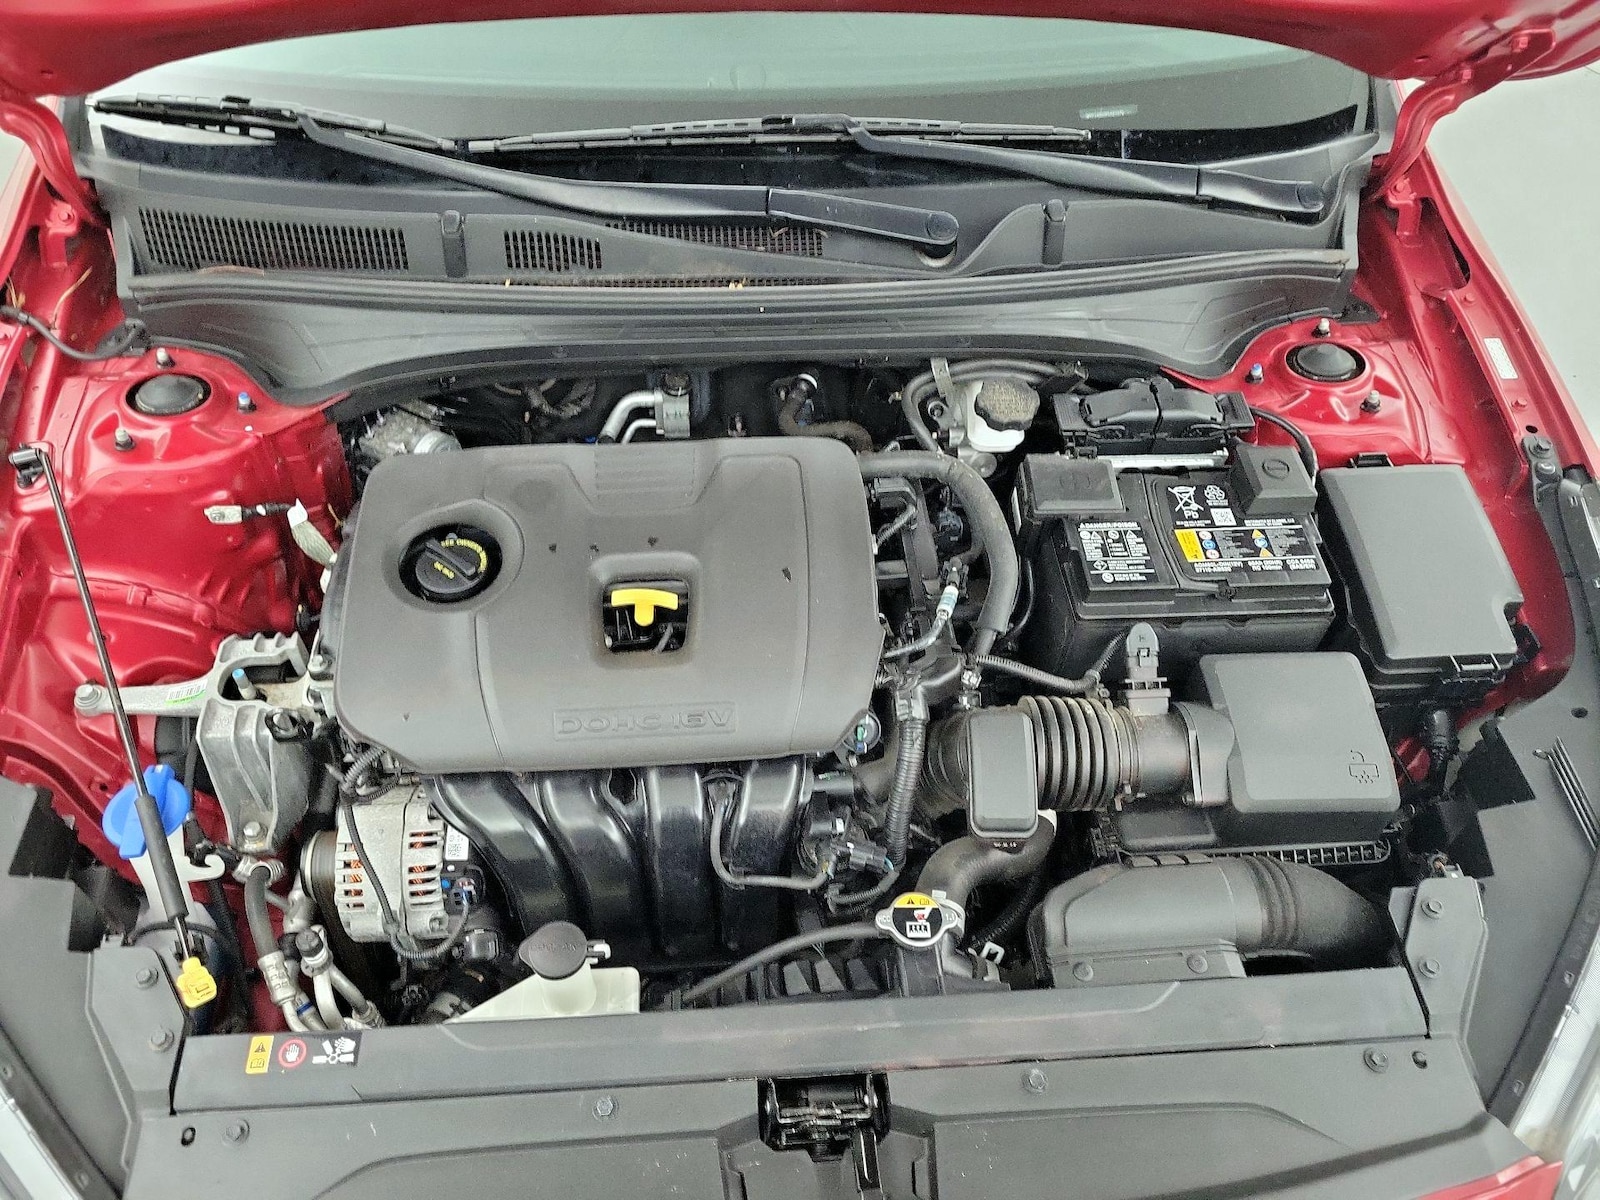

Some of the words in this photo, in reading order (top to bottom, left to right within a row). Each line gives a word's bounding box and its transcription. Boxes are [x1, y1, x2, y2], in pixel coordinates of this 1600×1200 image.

[1184, 509, 1199, 519] Pb
[558, 714, 662, 735] DOHC
[671, 708, 734, 730] 16V
